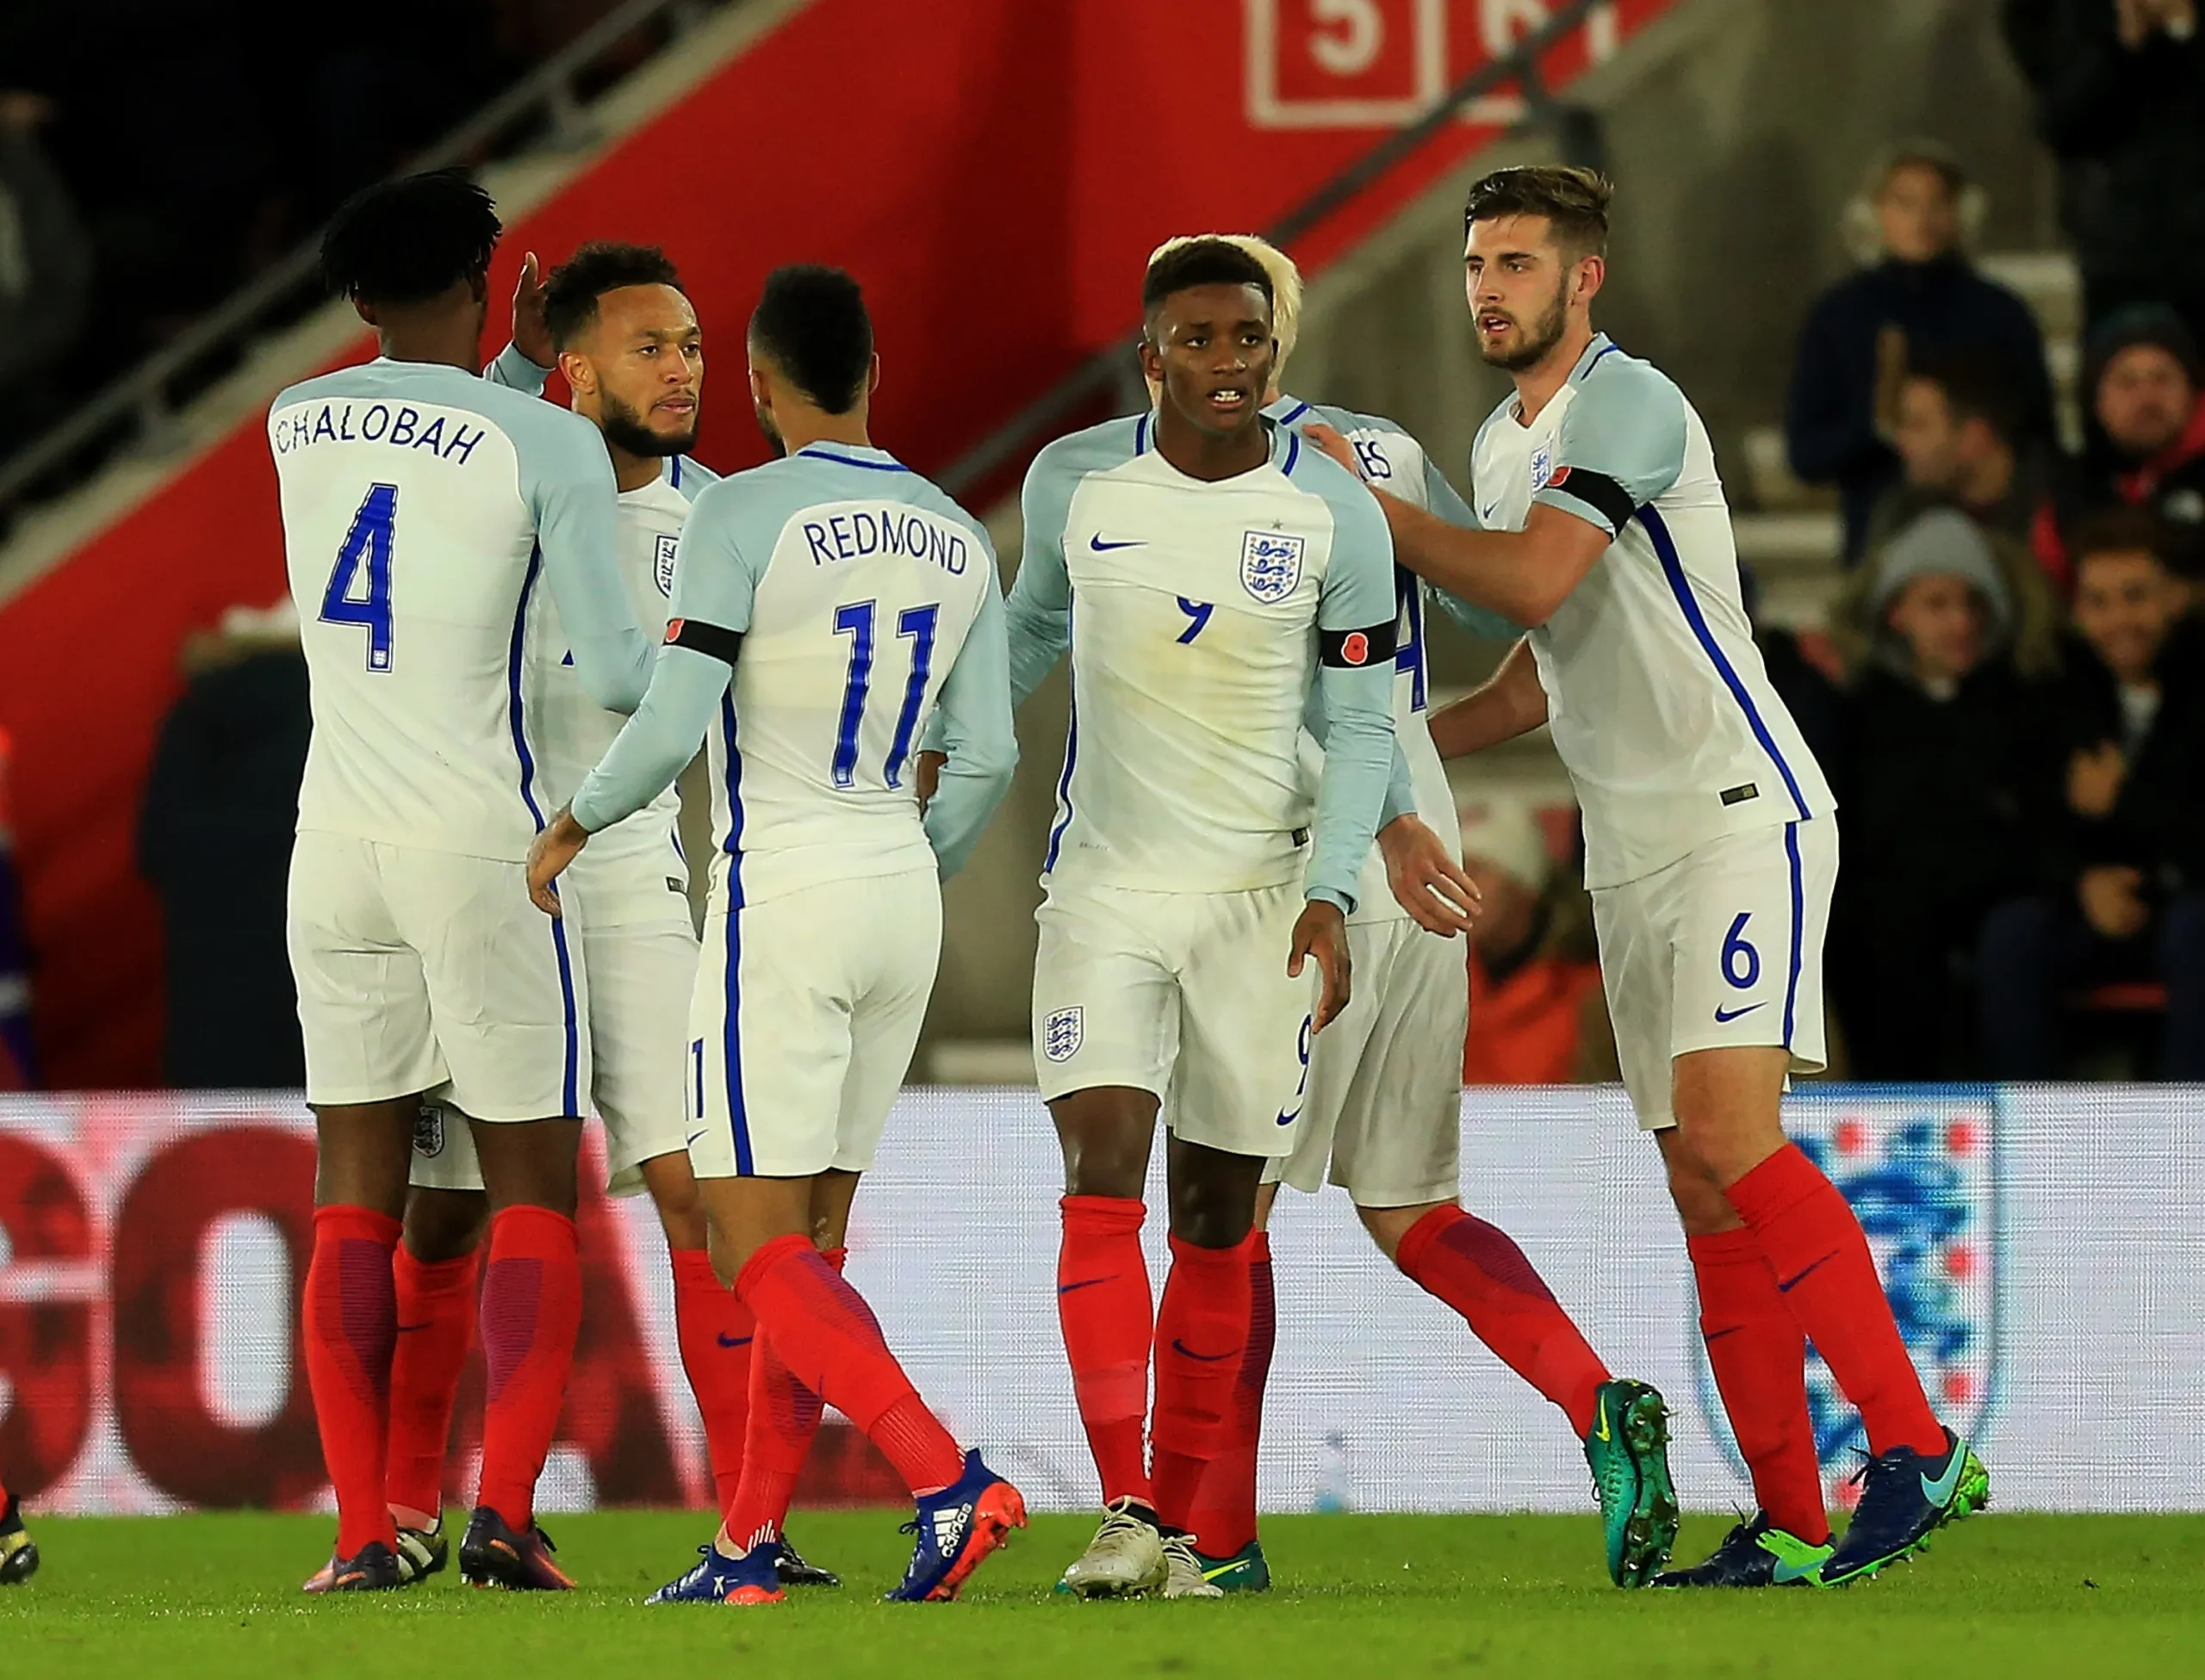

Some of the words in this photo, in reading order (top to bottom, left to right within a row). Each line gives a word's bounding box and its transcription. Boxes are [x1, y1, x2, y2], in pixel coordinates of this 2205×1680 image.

[274, 405, 486, 466] CHALOBAH
[318, 481, 399, 674] 4
[804, 510, 968, 576] REDMOND
[831, 598, 941, 790] 11
[1719, 911, 1761, 990] 6
